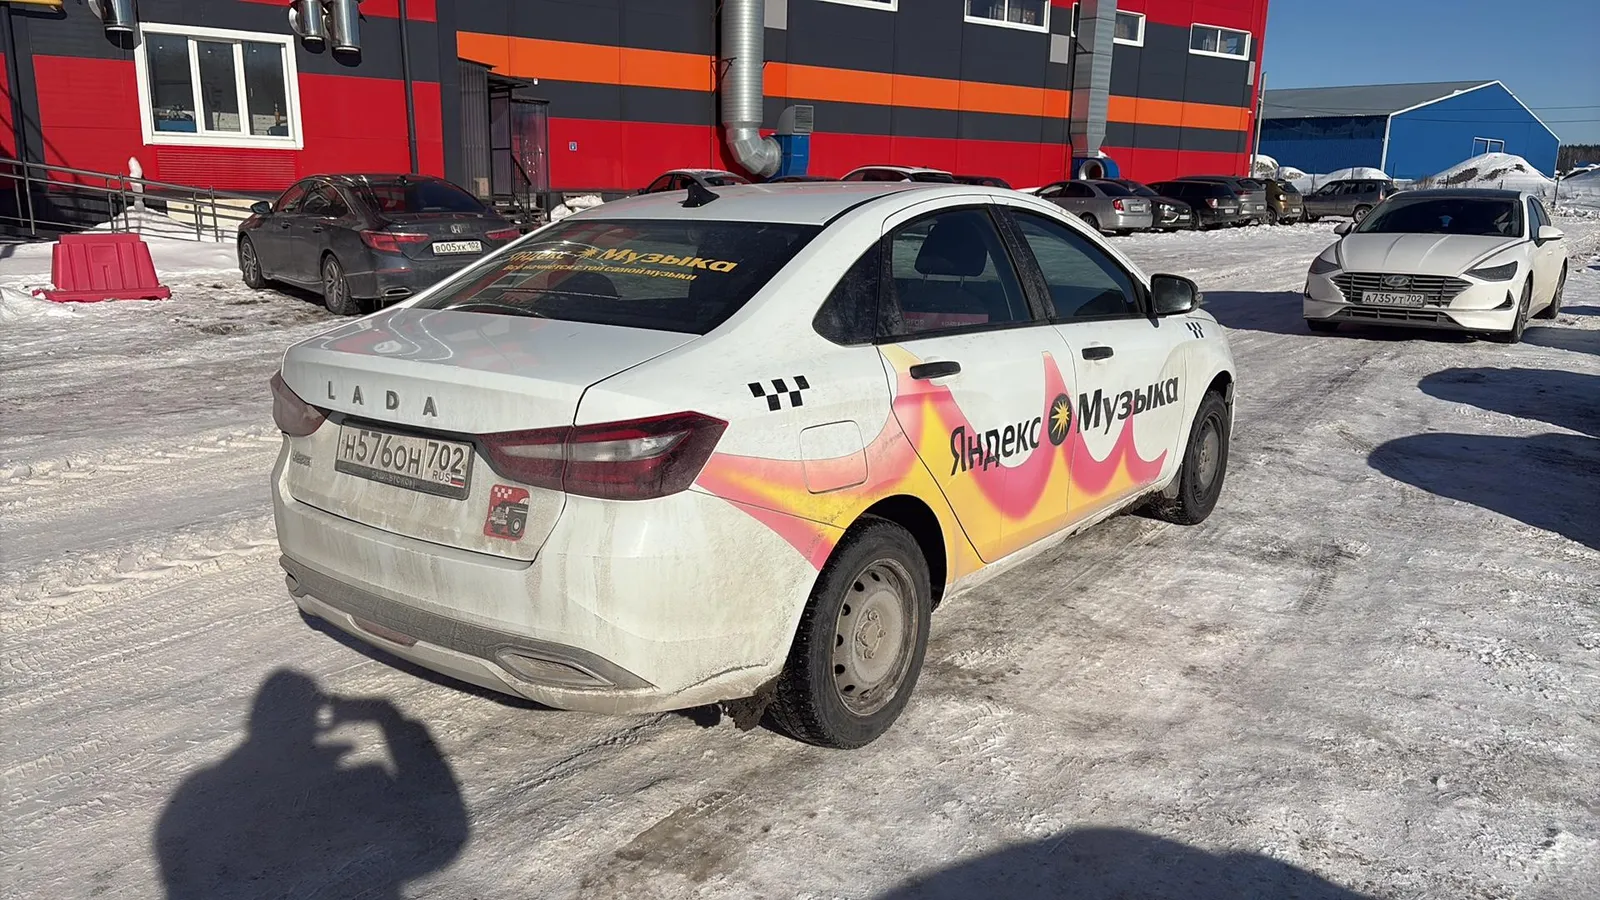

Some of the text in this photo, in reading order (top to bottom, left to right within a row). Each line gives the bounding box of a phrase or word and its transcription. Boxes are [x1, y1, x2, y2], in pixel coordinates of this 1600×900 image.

[596, 248, 738, 273] Музыка
[603, 264, 646, 276] самой
[644, 268, 698, 280] музыки
[1405, 294, 1423, 303] 702
[327, 380, 438, 418] LADA
[950, 376, 1179, 476] Яндекс Музыка
[427, 441, 464, 475] 702
[432, 470, 451, 483] RUS
